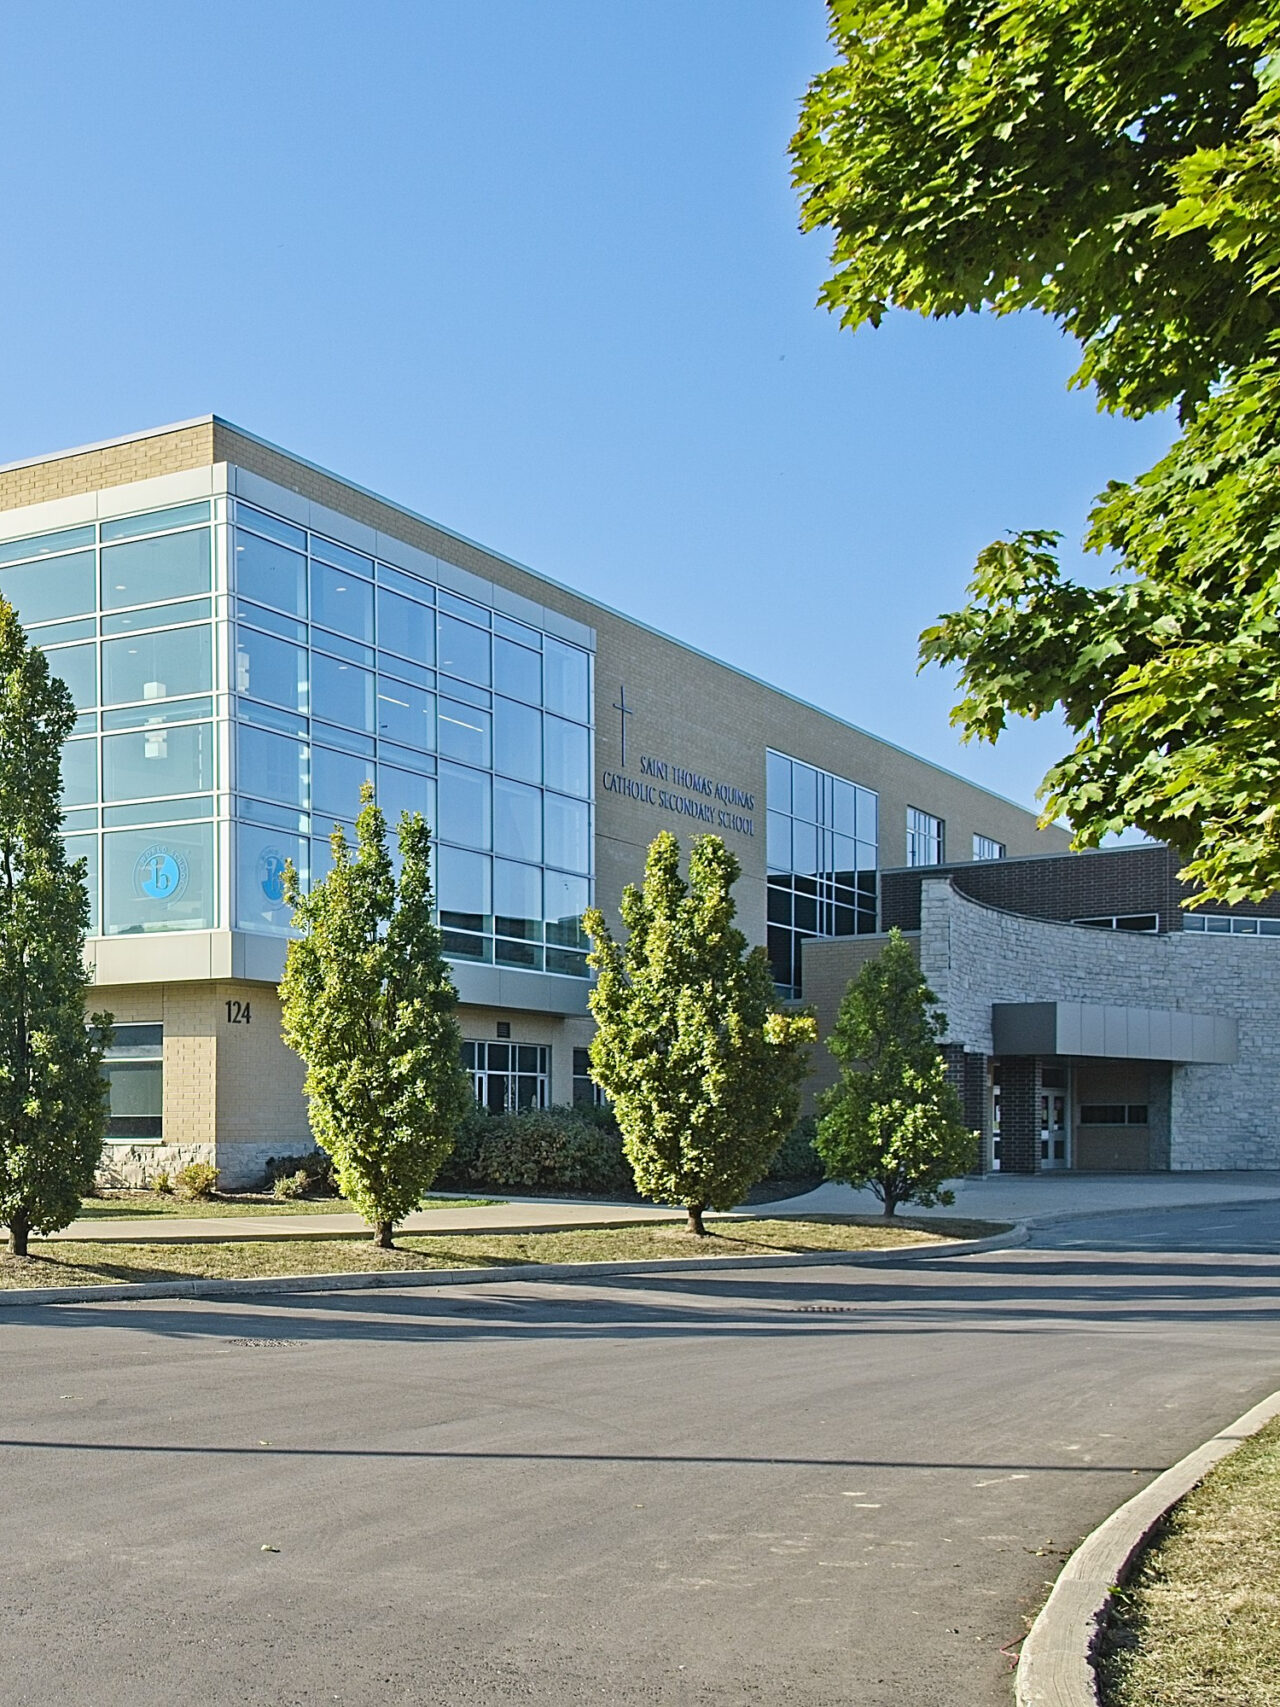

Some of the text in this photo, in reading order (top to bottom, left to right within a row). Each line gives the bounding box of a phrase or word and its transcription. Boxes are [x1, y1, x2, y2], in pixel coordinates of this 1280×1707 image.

[602, 770, 755, 837] CATHOLIC SECONDARY SCHOOL
[640, 755, 755, 811] SAINT THOMAS AQUINAS
[225, 1000, 252, 1024] 124
